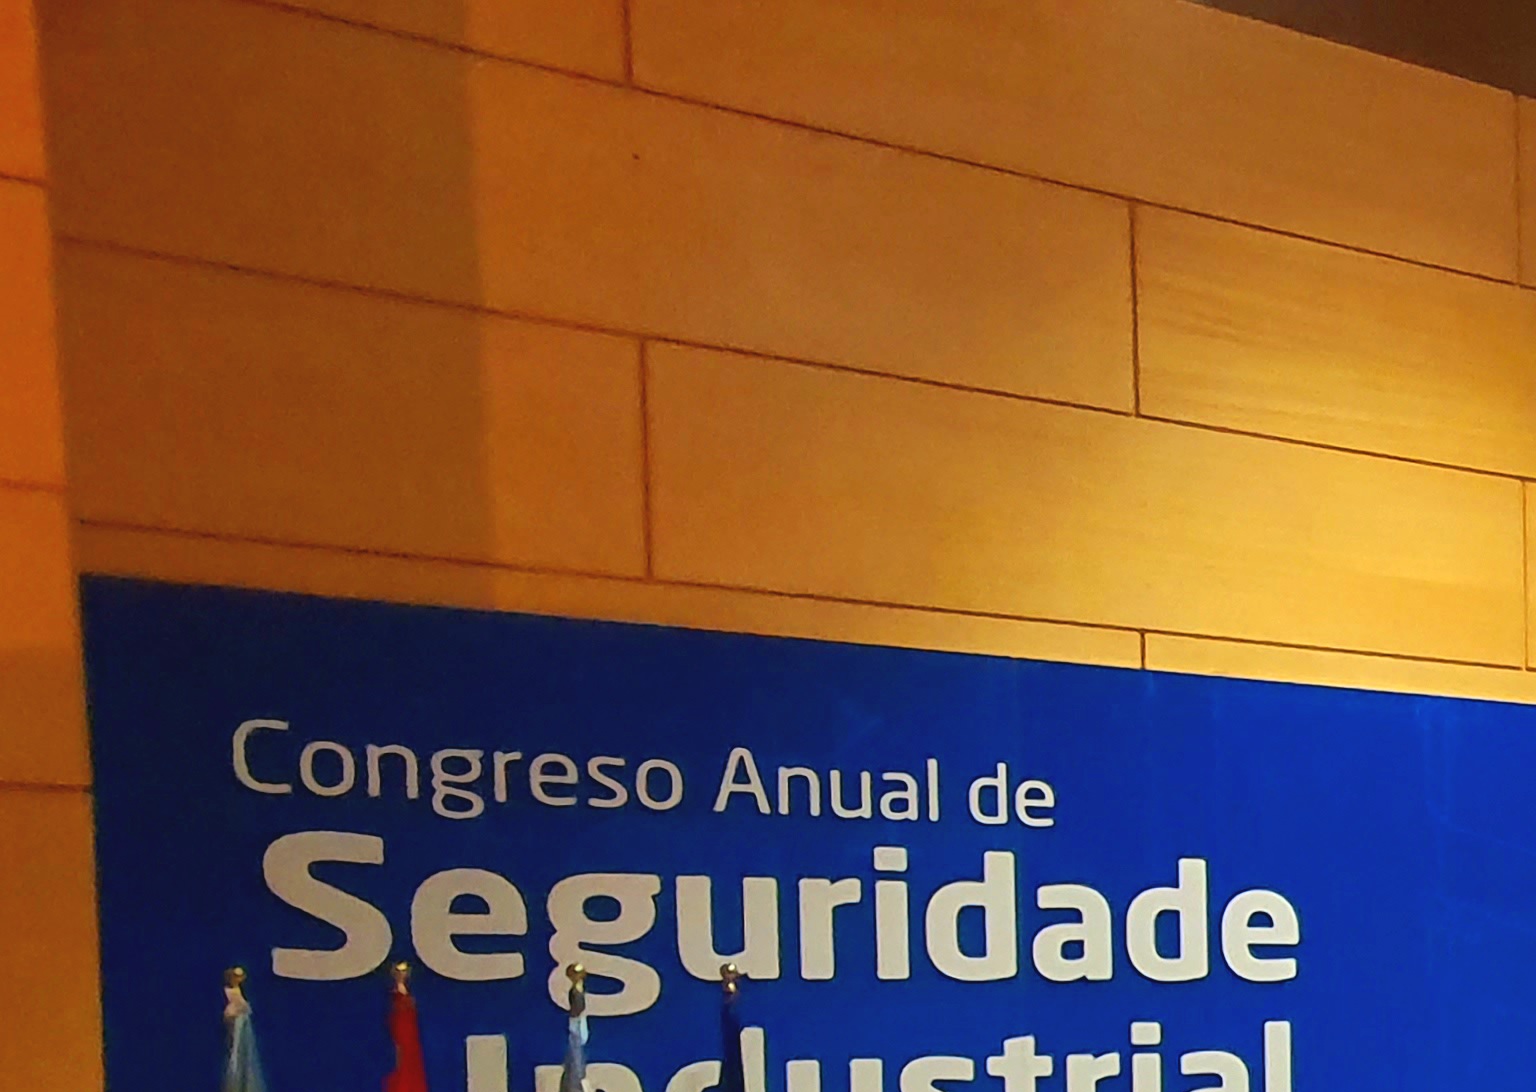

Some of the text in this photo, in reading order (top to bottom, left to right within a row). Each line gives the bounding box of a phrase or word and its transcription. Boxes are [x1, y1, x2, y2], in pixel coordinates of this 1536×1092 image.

[233, 719, 1056, 828] Congreso Anual de
[261, 830, 1301, 1018] Seguridade
